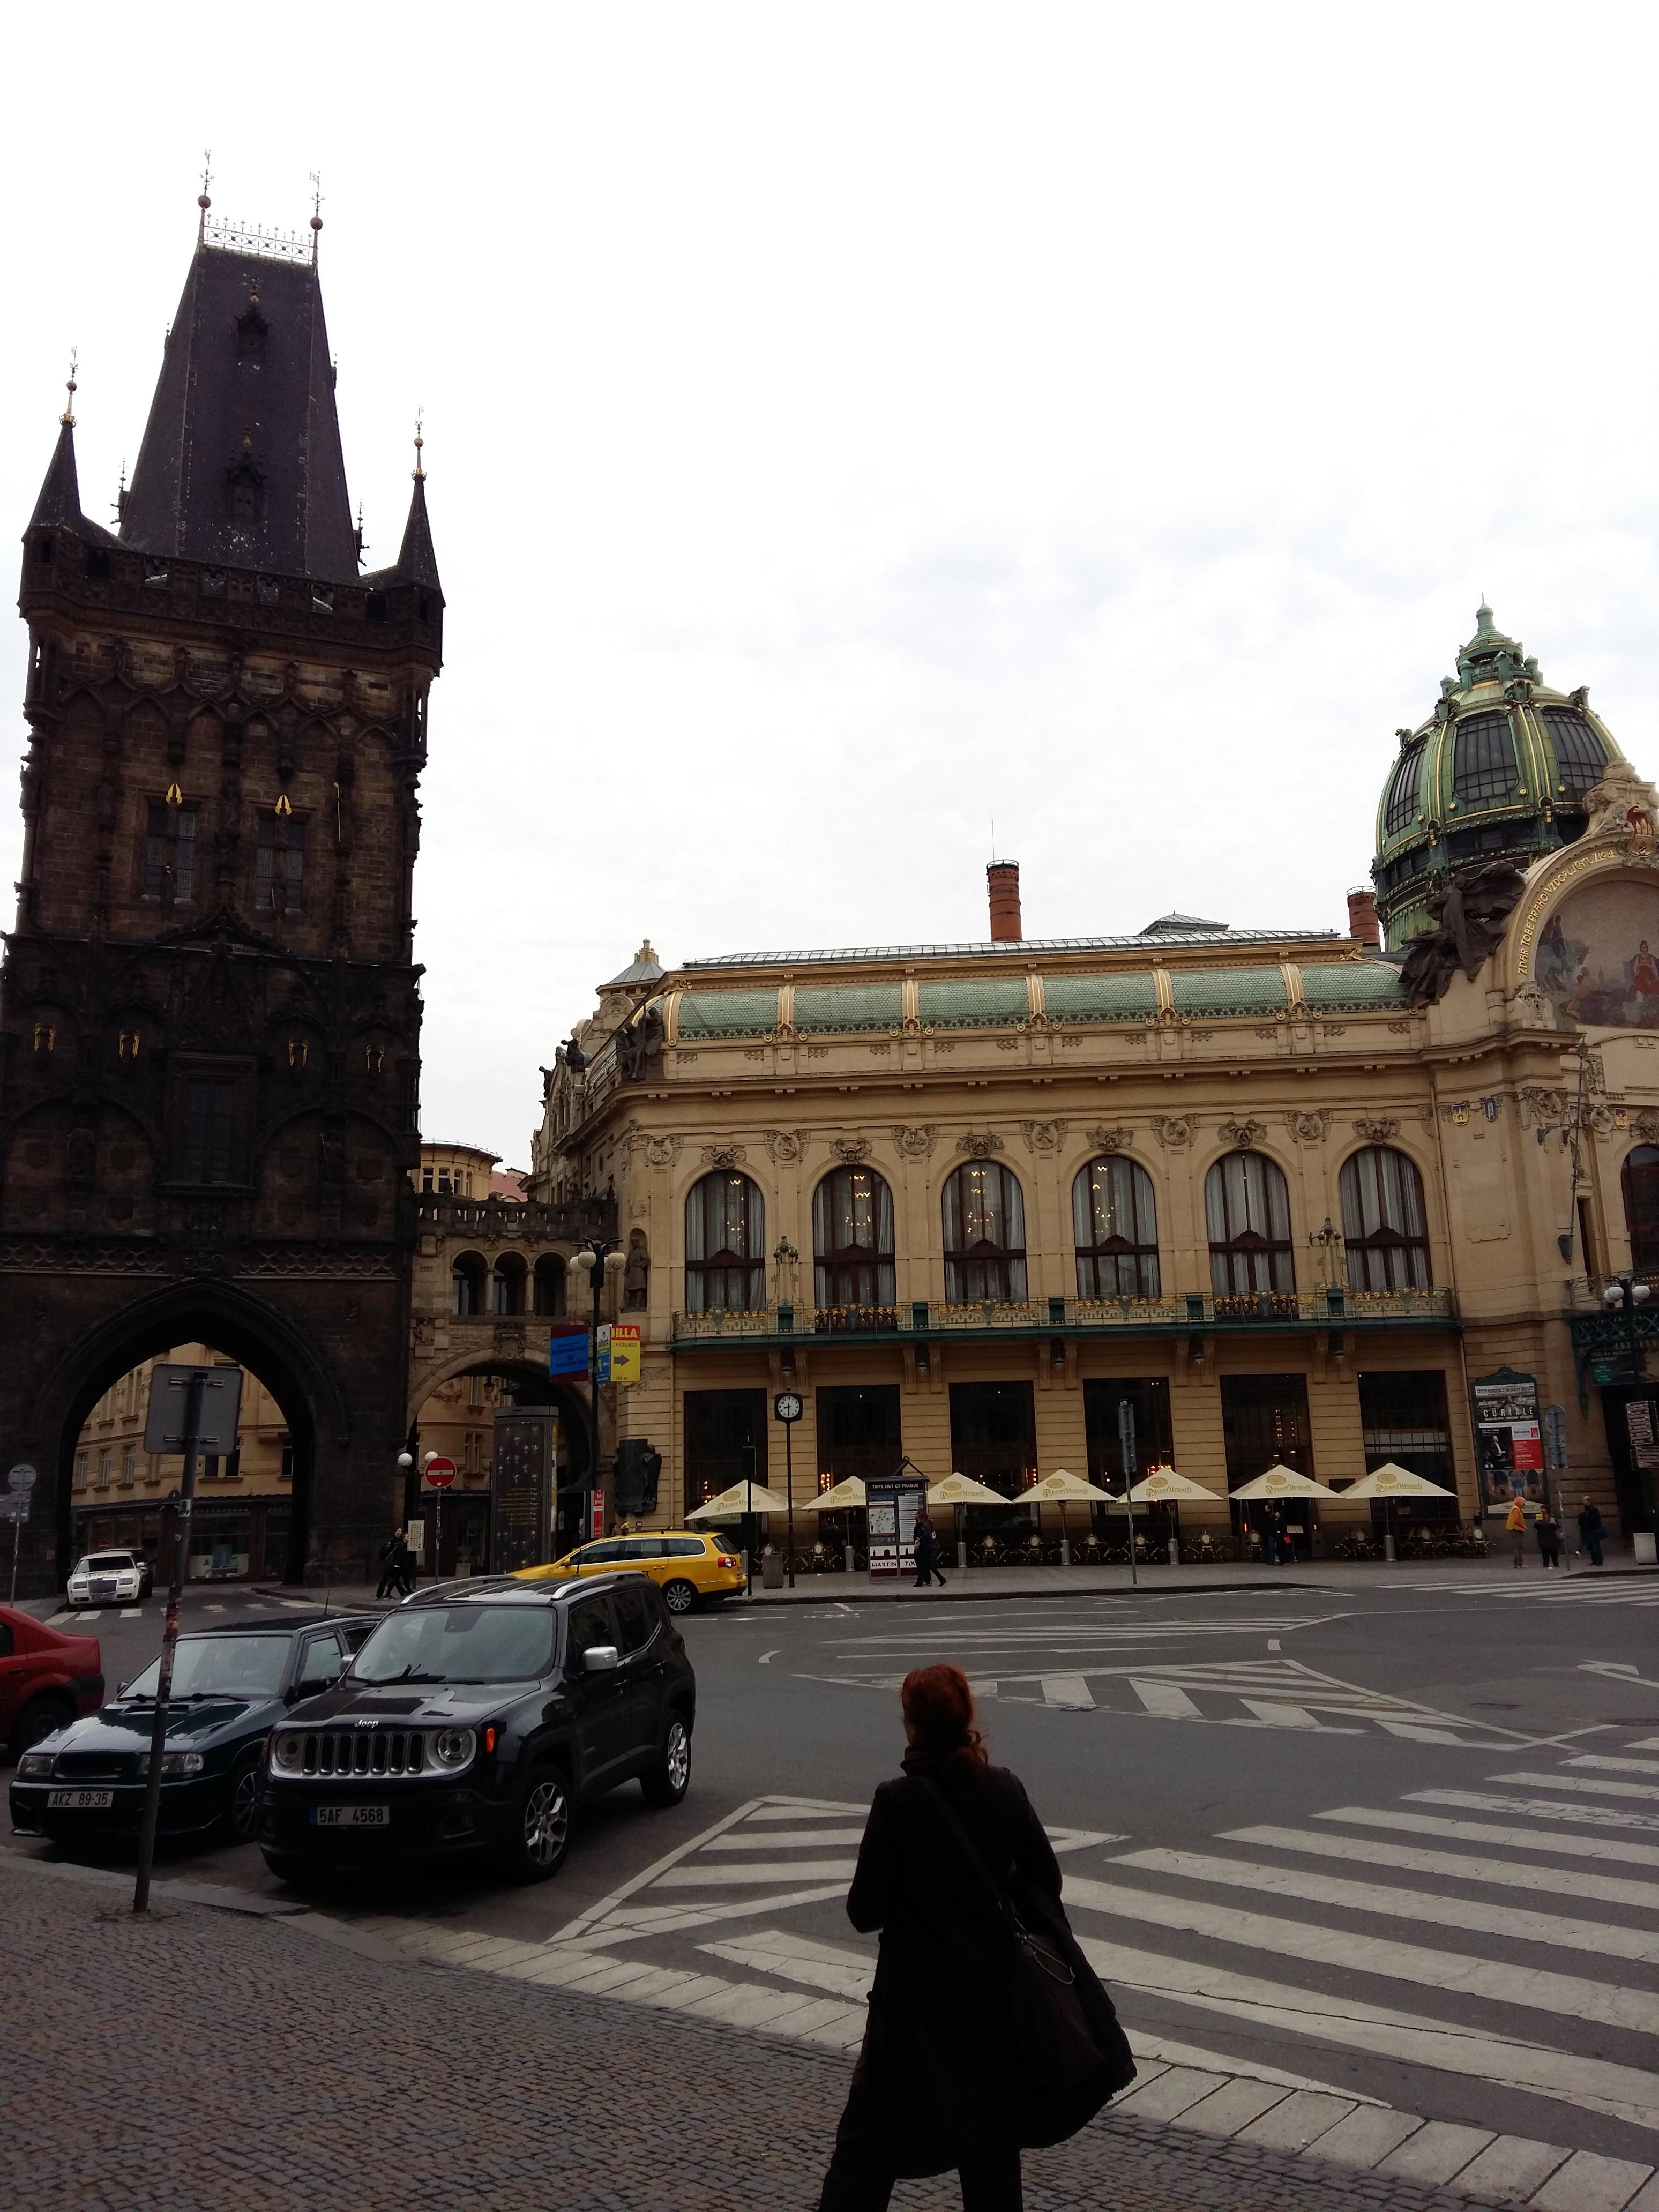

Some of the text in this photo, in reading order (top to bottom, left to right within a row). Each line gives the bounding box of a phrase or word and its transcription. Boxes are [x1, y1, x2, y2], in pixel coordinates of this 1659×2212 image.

[1518, 948, 1529, 976] ZDAR
[1265, 1485, 1287, 1494] Pilsner
[1376, 1484, 1398, 1493] Pilsner
[354, 1719, 379, 1729] Jeep
[52, 1792, 109, 1806] AKZ 89-35
[319, 1807, 384, 1823] 5AF 4568
